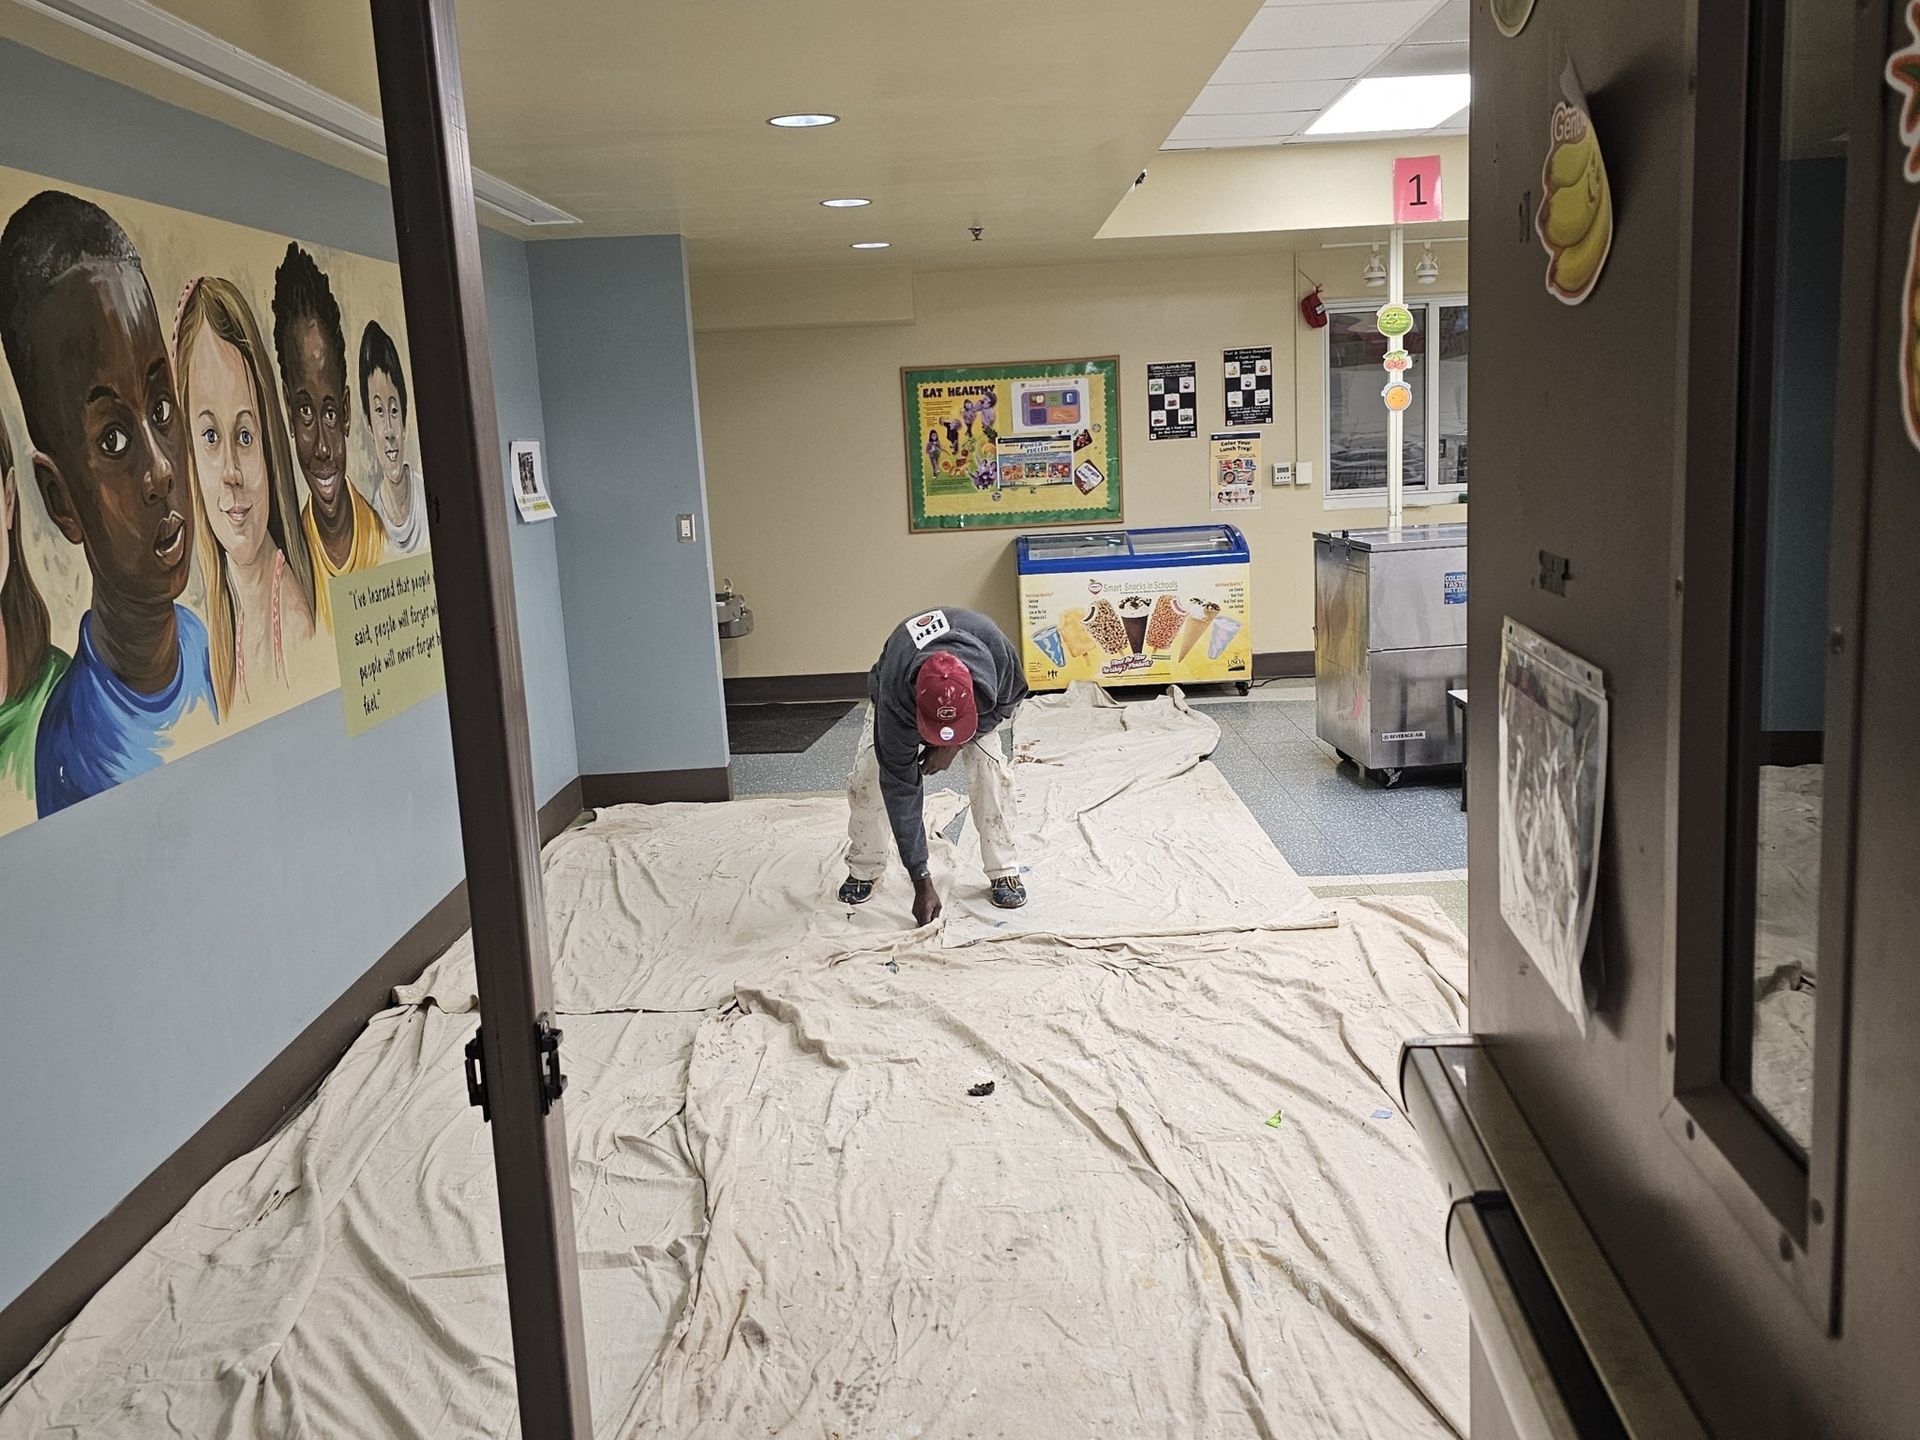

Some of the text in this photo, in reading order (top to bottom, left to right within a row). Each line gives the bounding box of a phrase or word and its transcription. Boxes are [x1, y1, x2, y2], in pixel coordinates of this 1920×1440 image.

[1408, 174, 1428, 206] 1
[923, 384, 996, 399] EAT HEALTHY
[1219, 445, 1237, 453] Lunch
[367, 578, 396, 604] learned
[396, 576, 410, 596] that
[411, 569, 431, 597] people
[1103, 583, 1122, 593] Smart
[1124, 582, 1147, 592] Snacks
[1147, 582, 1154, 590] in
[1154, 580, 1178, 590] Schools
[355, 623, 373, 647] said,
[374, 614, 397, 647] people
[398, 608, 410, 629] will
[410, 604, 430, 628] forget
[359, 654, 382, 688] people
[383, 647, 396, 670] will
[397, 644, 415, 665] never
[416, 634, 436, 658] forget
